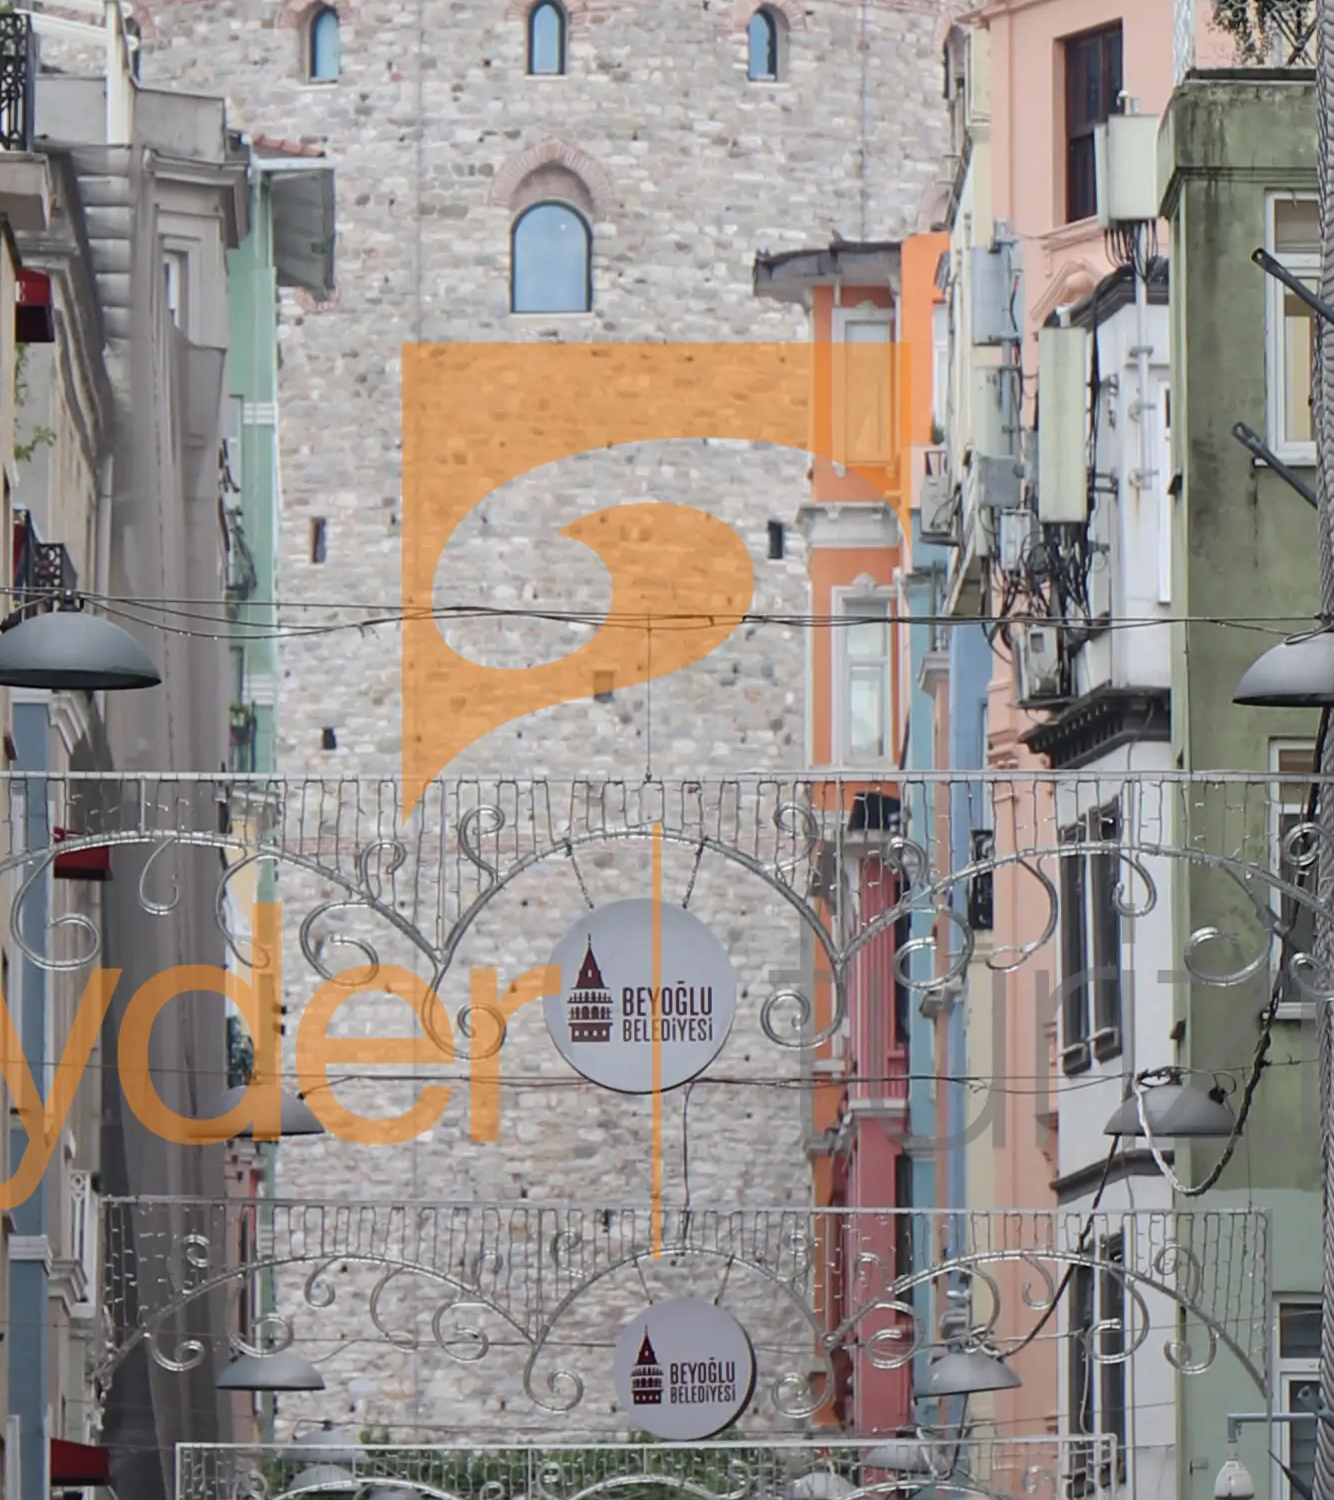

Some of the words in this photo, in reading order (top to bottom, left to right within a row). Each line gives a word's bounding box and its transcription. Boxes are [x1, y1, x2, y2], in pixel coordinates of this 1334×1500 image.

[622, 980, 713, 1016] BEYOĞLU
[622, 1017, 714, 1042] BELEDİYESİ
[669, 1357, 736, 1385] BEYOĞLU
[670, 1384, 737, 1404] BELEDİYESİ
